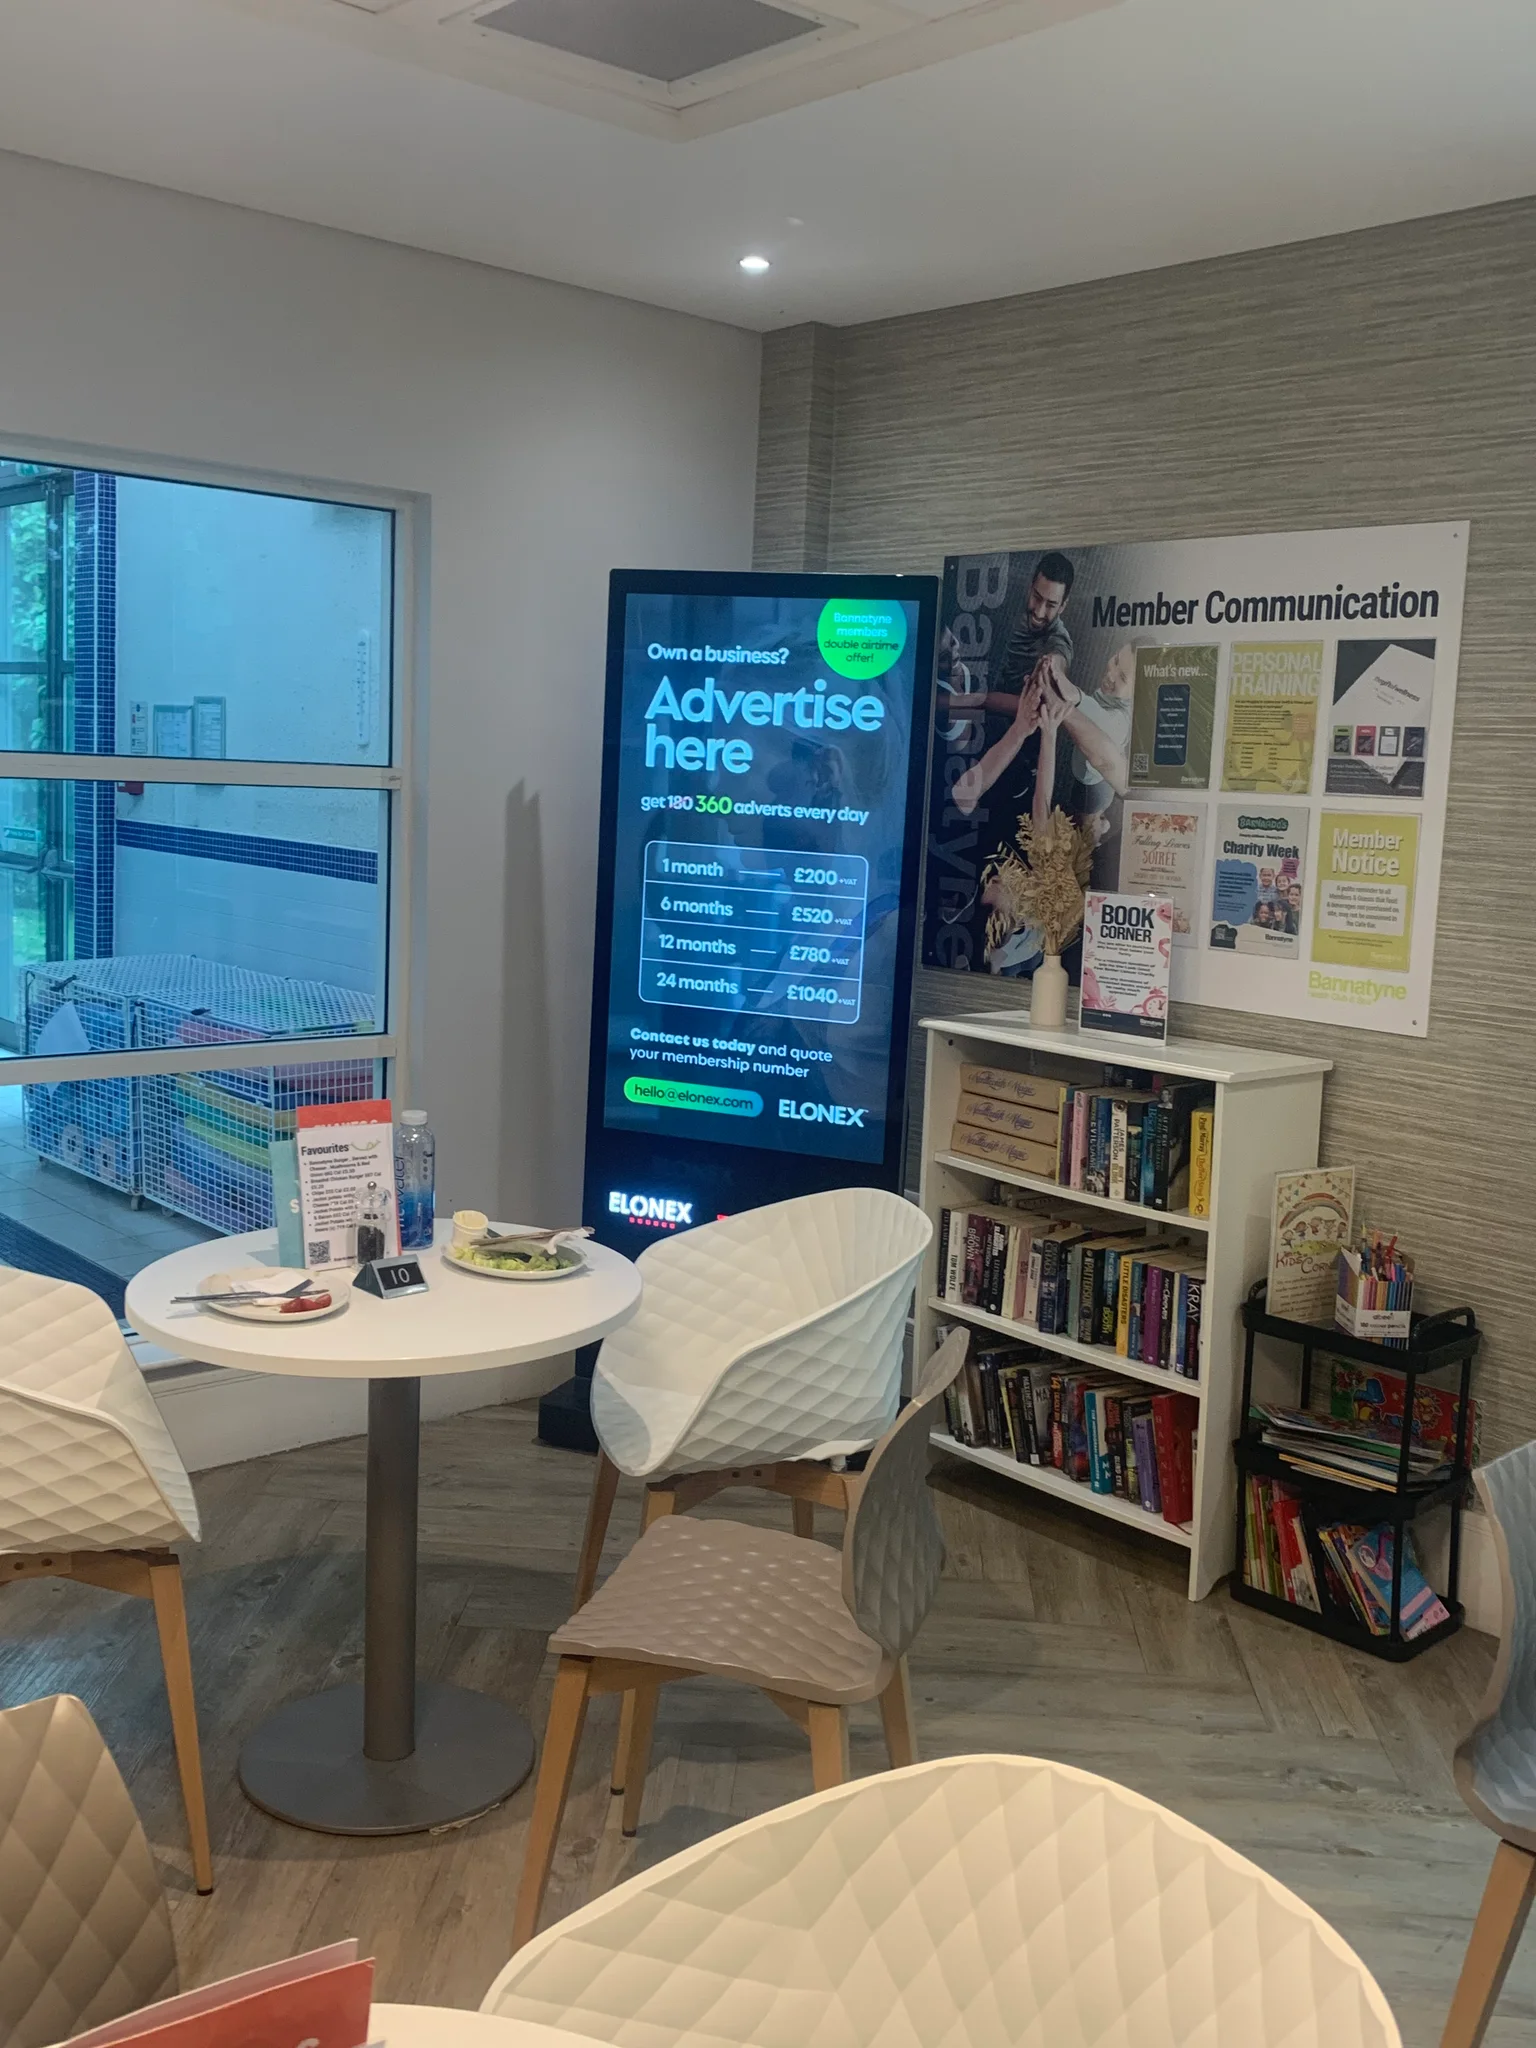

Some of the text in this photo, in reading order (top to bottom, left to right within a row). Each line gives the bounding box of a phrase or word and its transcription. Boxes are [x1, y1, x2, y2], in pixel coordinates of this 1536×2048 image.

[834, 612, 892, 626] Bannatyne
[1092, 582, 1440, 629] Member Communication
[823, 638, 899, 651] double airtime
[836, 626, 888, 637] members
[647, 643, 789, 665] Own a business?
[846, 652, 874, 664] offer!
[1232, 652, 1322, 673] PERSONAL
[1143, 664, 1176, 678] What's
[1231, 672, 1322, 697] TRAINING
[644, 675, 885, 731] Advertise
[645, 723, 753, 774] here
[928, 555, 1008, 971] Bannatyne
[641, 795, 869, 826] get 180 360 adverts every day
[1132, 835, 1162, 850] Falling
[1223, 840, 1300, 859] Charity Week
[1333, 828, 1404, 852] Member
[662, 858, 669, 873] 1
[671, 860, 724, 877] month
[794, 867, 838, 886] £200
[1332, 849, 1401, 877] Notice
[660, 896, 671, 911] 6
[673, 898, 733, 917] months
[791, 906, 833, 925] £520
[1101, 904, 1155, 929] BOOK
[1100, 924, 1151, 943] CORNER
[658, 934, 674, 949] 12
[676, 937, 736, 955] months
[789, 946, 830, 964] £780
[656, 972, 676, 988] 24
[678, 976, 739, 995] months
[786, 984, 838, 1003] £1040
[1308, 970, 1408, 1000] Bannatyne
[630, 1027, 833, 1063] Contact us today and quote
[629, 1047, 809, 1078] your membership number
[634, 1083, 753, 1111] hello@elonex.com
[778, 1098, 865, 1128] ELONEX
[1089, 1122, 1097, 1144] EVIL
[1112, 1119, 1120, 1160] PATTERSON
[1198, 1133, 1206, 1152] Murray
[301, 1142, 349, 1156] Favourites
[608, 1191, 693, 1225] ELONEX
[966, 1228, 976, 1260] BROWN
[1044, 1242, 1052, 1276] CHAOS
[1275, 1254, 1333, 1274] KIDS CORN
[389, 1267, 410, 1285] 10
[949, 1269, 957, 1291] WOLFE
[1082, 1262, 1094, 1307] PATTERSON
[1120, 1261, 1130, 1325] LITTLE DISASTERS
[1162, 1289, 1170, 1320] Cleeves
[1187, 1284, 1200, 1322] KRAY
[1102, 1307, 1110, 1334] BOOTH
[1114, 1456, 1123, 1488] BLIND EYE
